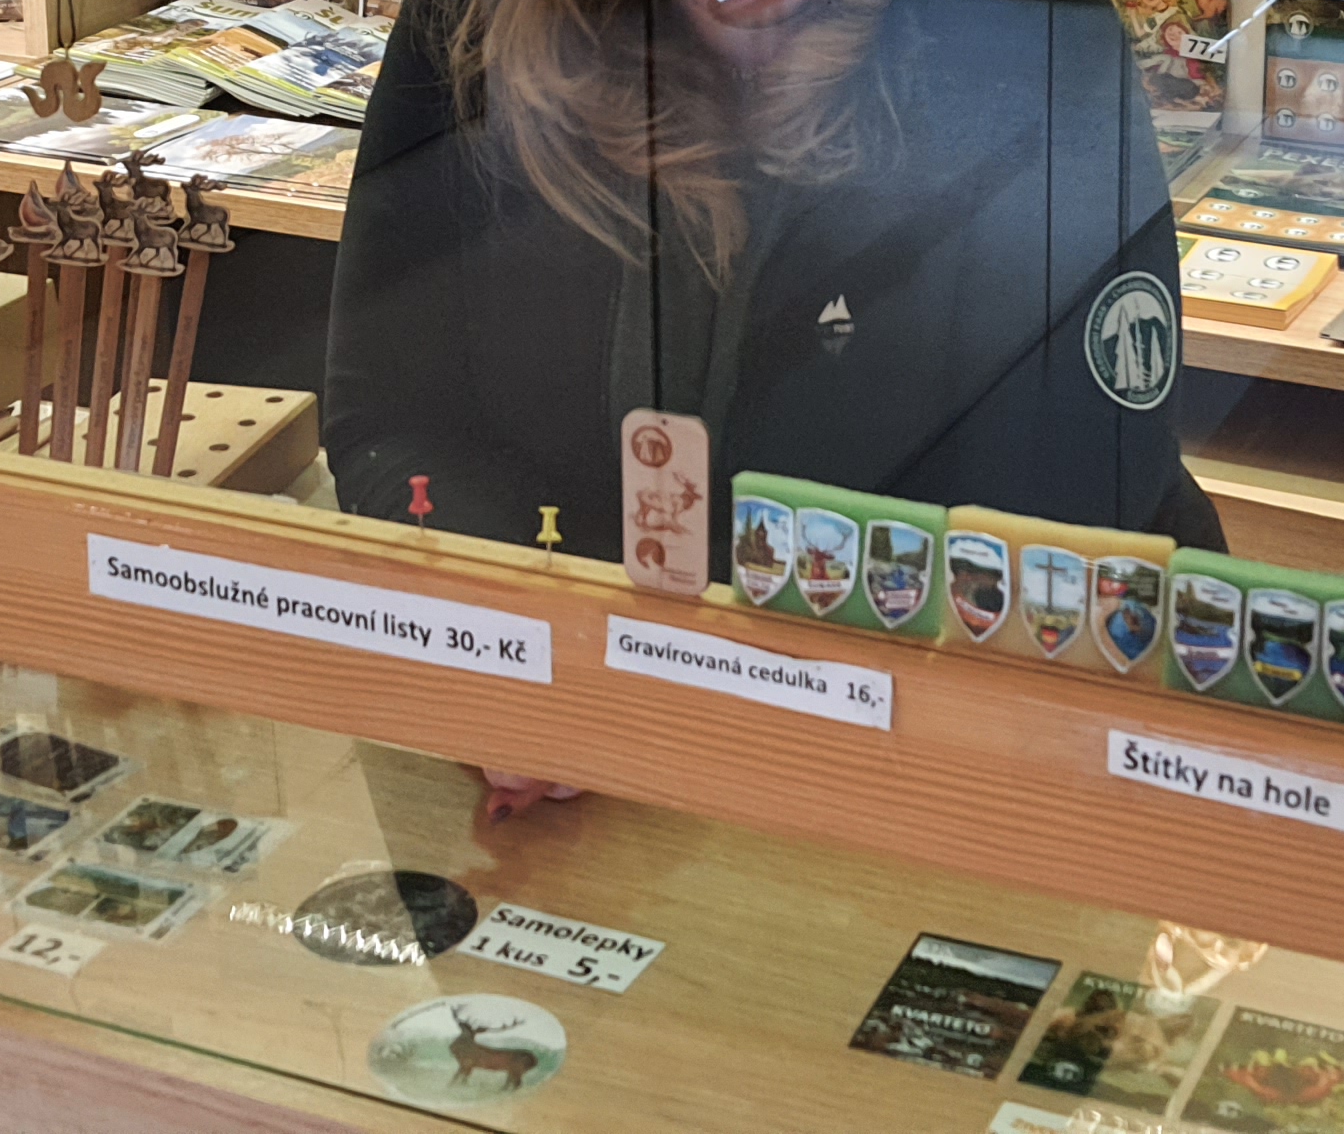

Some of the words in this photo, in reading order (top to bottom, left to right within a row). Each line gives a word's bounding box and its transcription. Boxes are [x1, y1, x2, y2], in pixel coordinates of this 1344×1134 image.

[106, 556, 270, 610] Samoobslužné
[276, 592, 377, 632] pracovní
[383, 612, 433, 648] listy
[446, 625, 492, 659] 30,-
[498, 637, 528, 664] Kč
[618, 632, 743, 676] Gravírovaná
[748, 664, 829, 695] cedulka
[846, 681, 886, 708] 16,-
[1123, 739, 1208, 792] Štítky
[1218, 772, 1253, 798] na
[1263, 776, 1331, 817] hole
[8, 932, 81, 966] 12,-
[471, 935, 491, 953] 1
[496, 941, 550, 966] kus
[567, 956, 621, 986] 5,-
[490, 908, 655, 963] Samolepky
[891, 1004, 991, 1038] KVARTETO
